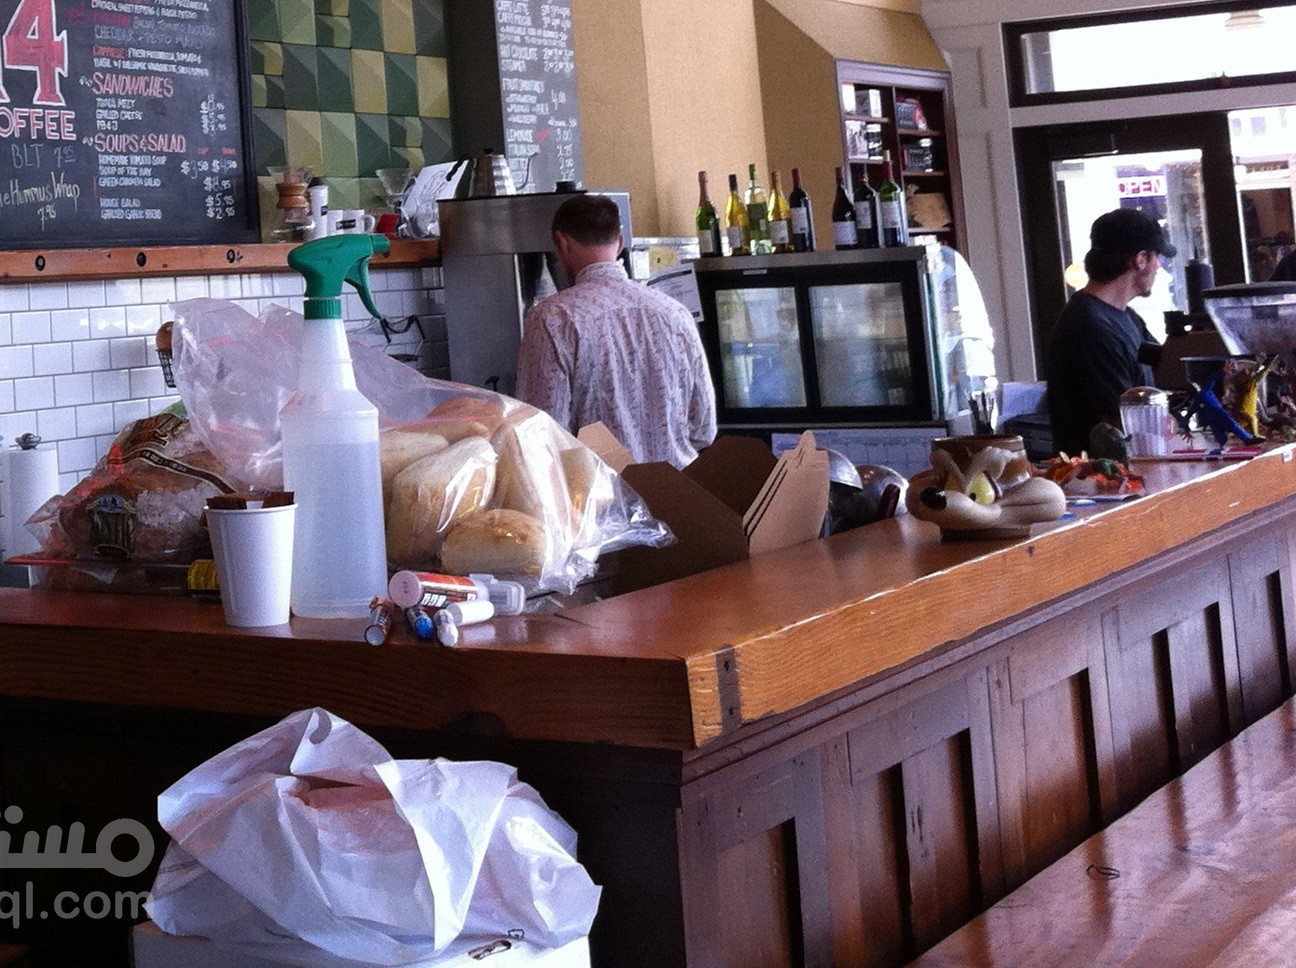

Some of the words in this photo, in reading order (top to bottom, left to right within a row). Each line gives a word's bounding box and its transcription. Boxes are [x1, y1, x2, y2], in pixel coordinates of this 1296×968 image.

[92, 72, 174, 98] SANDWICHES
[11, 143, 44, 169] BLT
[94, 133, 139, 153] SOUPS
[148, 133, 186, 153] SALAD
[51, 171, 80, 212] Wrap
[1118, 178, 1163, 196] OPEN
